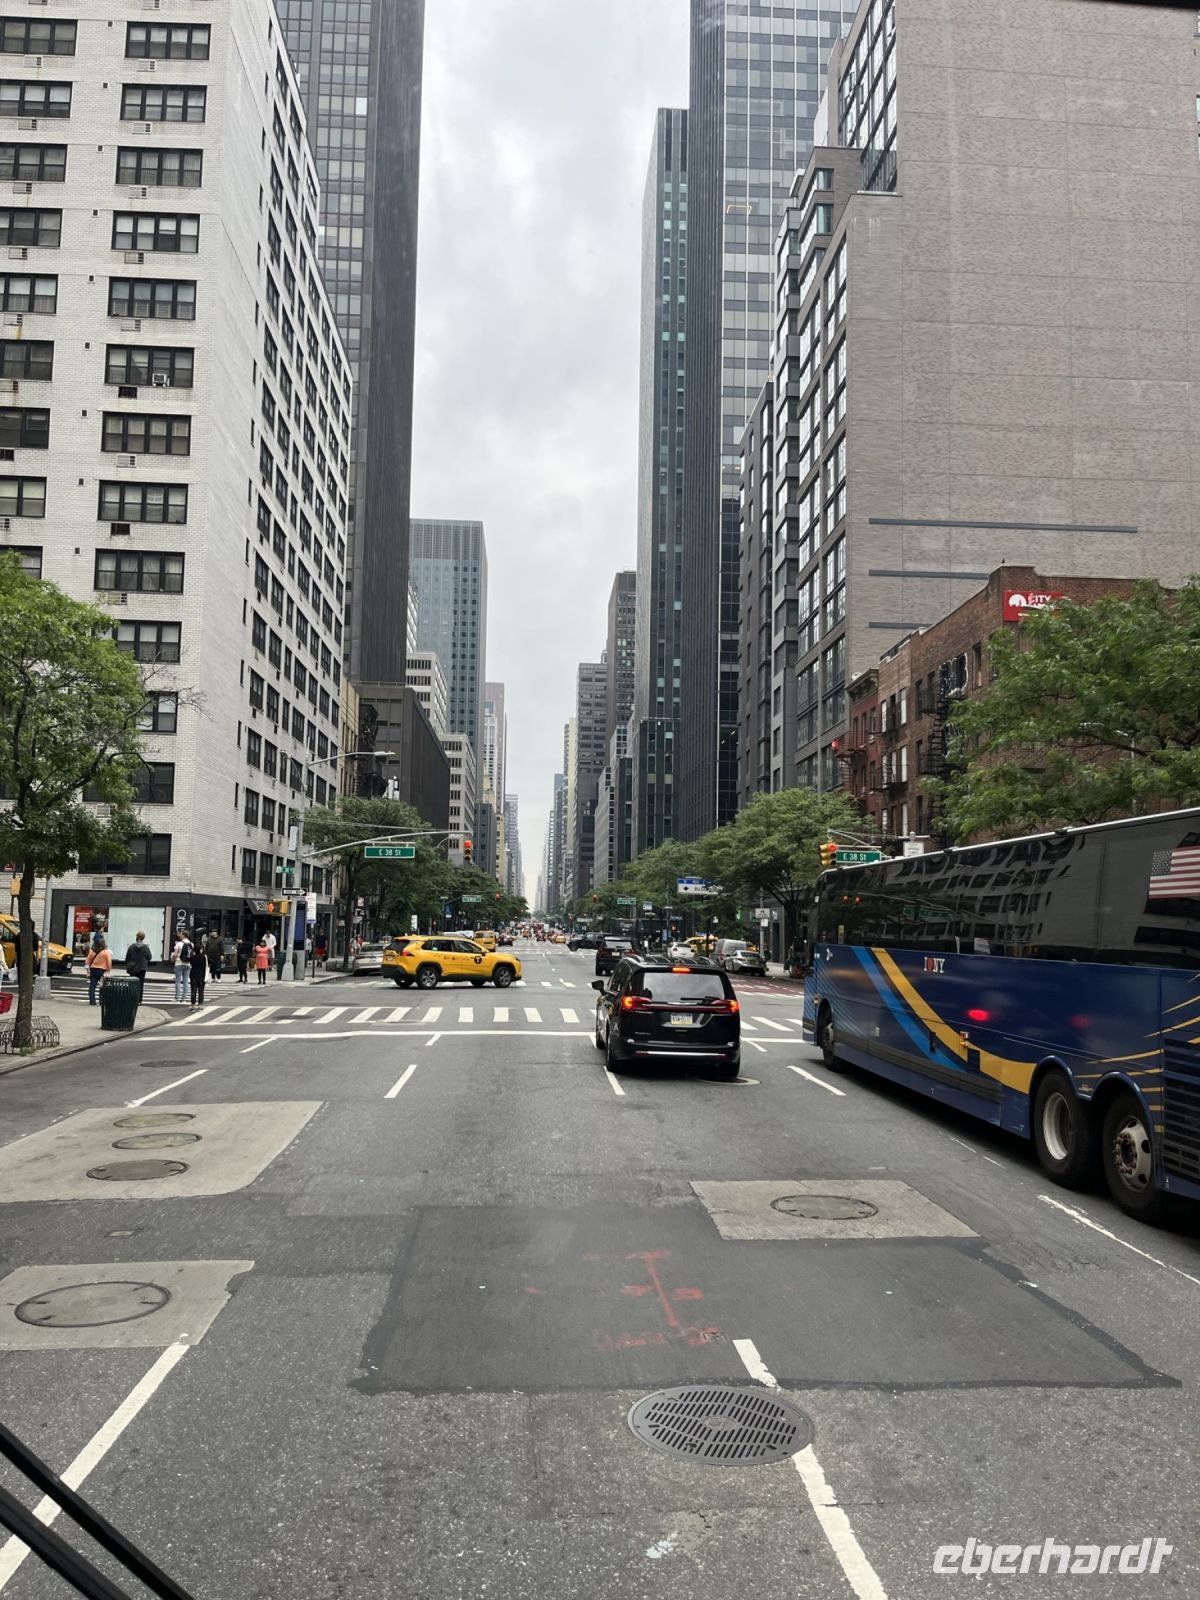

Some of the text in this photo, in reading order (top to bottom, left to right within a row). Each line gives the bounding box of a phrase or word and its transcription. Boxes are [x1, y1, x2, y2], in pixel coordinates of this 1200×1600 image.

[1028, 595, 1051, 604] CITY
[385, 848, 393, 856] 38
[395, 848, 402, 856] St
[849, 853, 858, 861] 38
[860, 853, 867, 861] St
